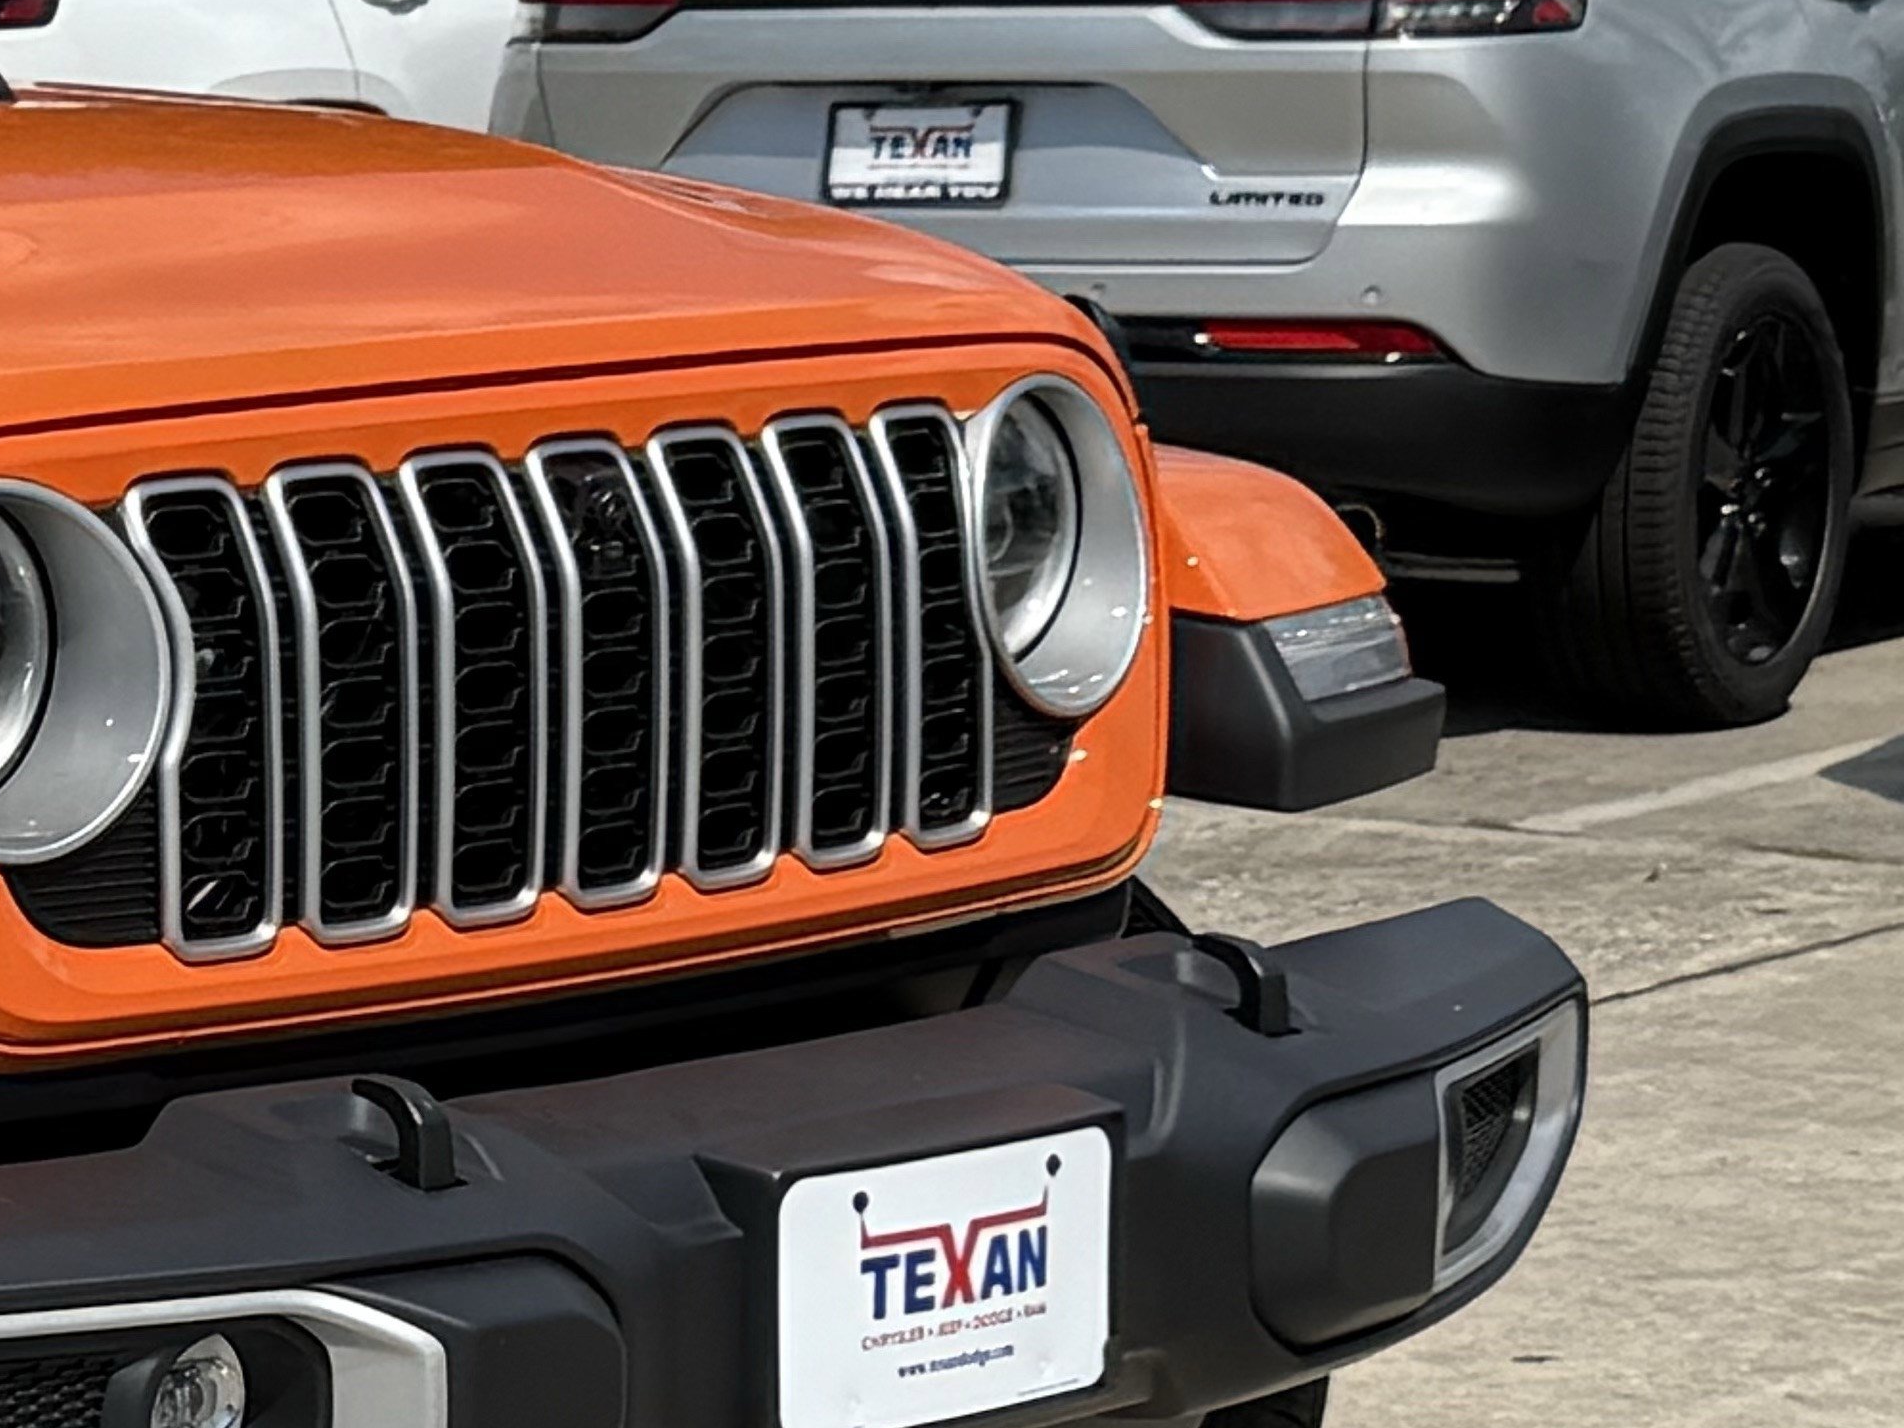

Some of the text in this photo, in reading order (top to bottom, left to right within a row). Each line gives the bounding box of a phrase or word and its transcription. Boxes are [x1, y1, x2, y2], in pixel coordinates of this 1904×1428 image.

[870, 129, 973, 159] TEXAN
[1209, 191, 1324, 206] LIMITED
[860, 1222, 1049, 1321] TEXAN
